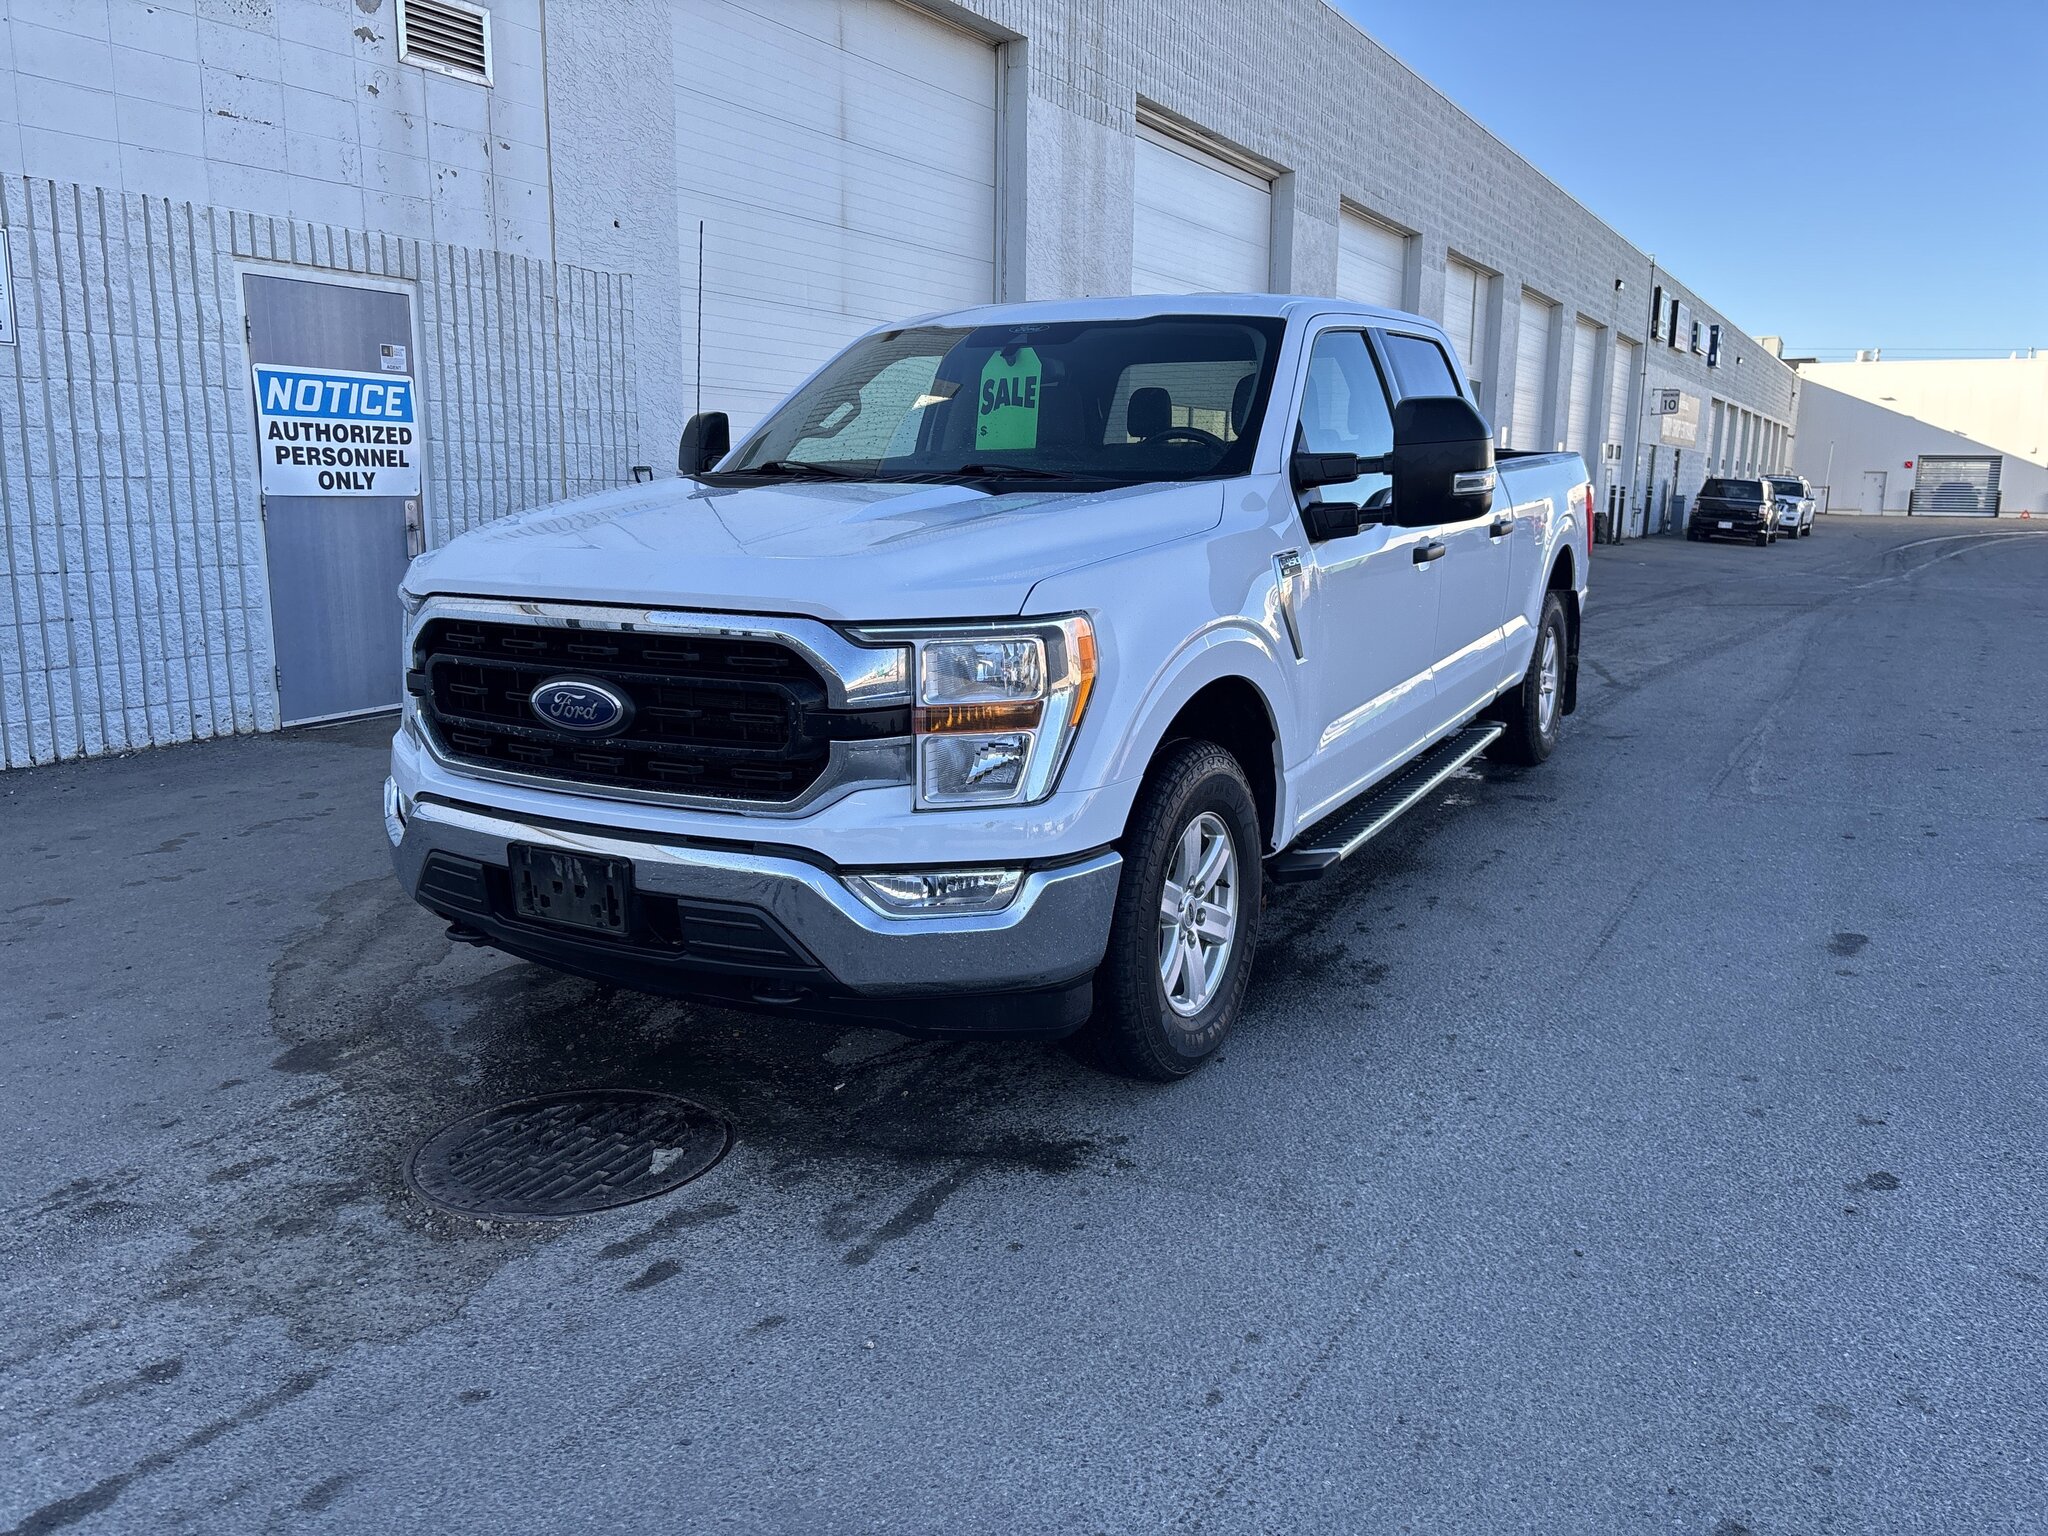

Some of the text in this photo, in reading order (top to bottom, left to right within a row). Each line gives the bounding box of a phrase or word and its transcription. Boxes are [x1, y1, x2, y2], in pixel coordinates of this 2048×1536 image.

[266, 376, 405, 417] NOTICE
[980, 375, 1037, 415] SALE
[1664, 399, 1676, 410] 10
[268, 421, 412, 445] AUTHORIZED
[980, 425, 988, 437] $
[275, 445, 410, 468] PERSONNEL
[318, 470, 376, 490] ONLY
[550, 691, 598, 720] Ford
